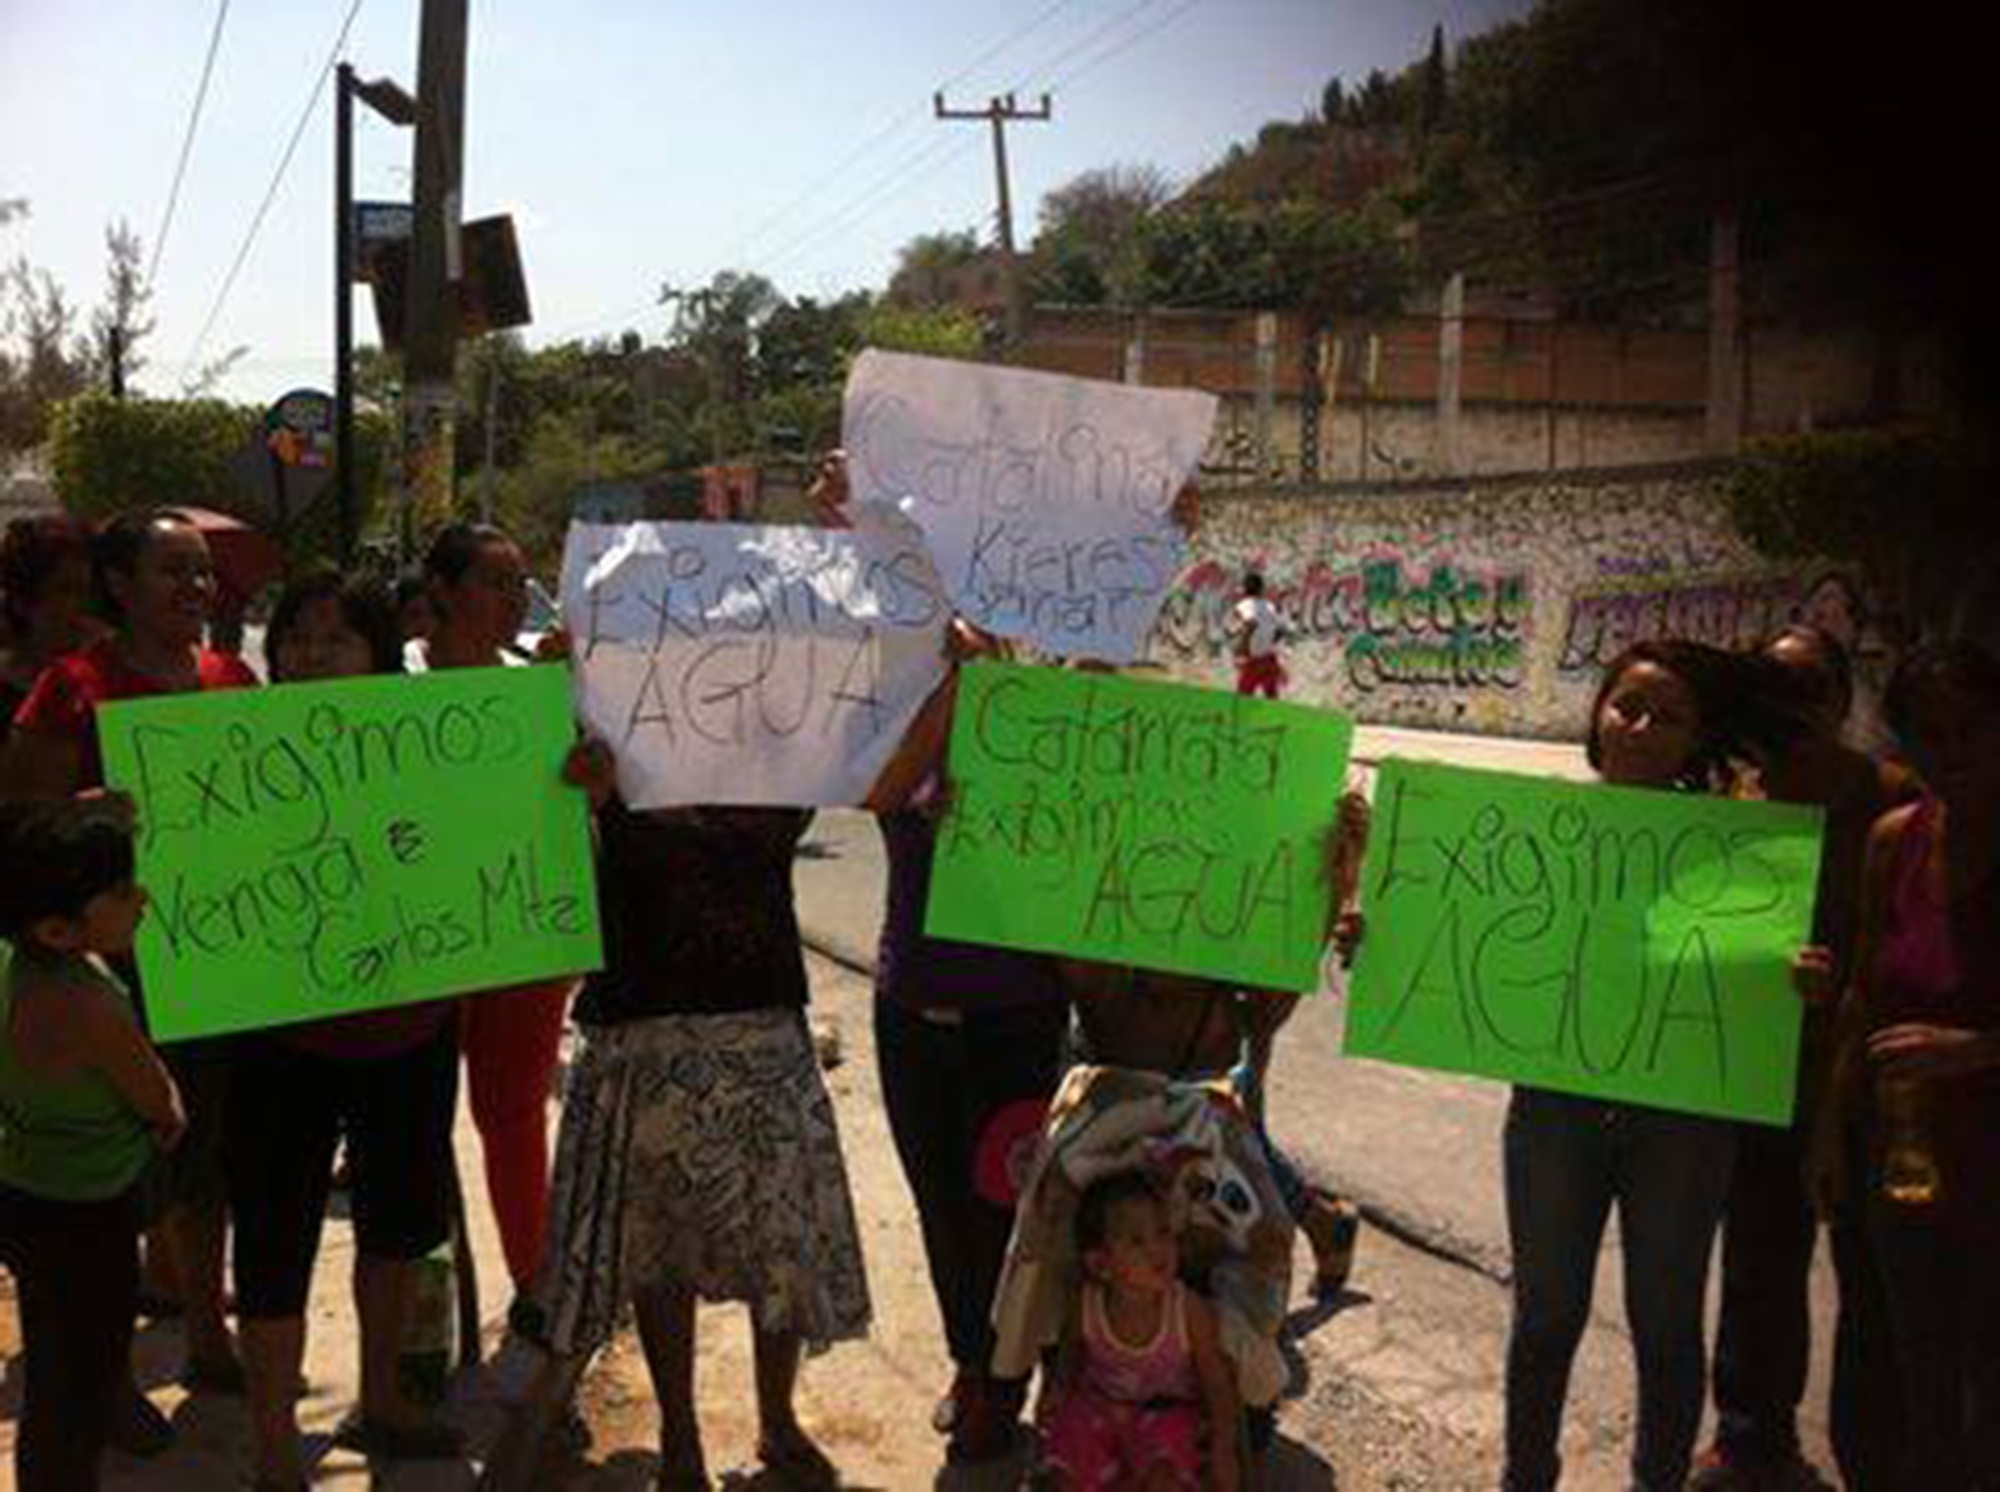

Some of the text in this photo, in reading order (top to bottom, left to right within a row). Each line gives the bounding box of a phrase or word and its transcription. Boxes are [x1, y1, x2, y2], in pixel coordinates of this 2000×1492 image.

[623, 626, 881, 750] AGUA
[132, 695, 522, 857] Exigimos
[147, 836, 364, 958] Venga
[1082, 839, 1295, 962] AGUA
[1377, 779, 1792, 941] Exigimos
[304, 893, 474, 992] Carlos
[1383, 900, 1727, 1098] AGUA
